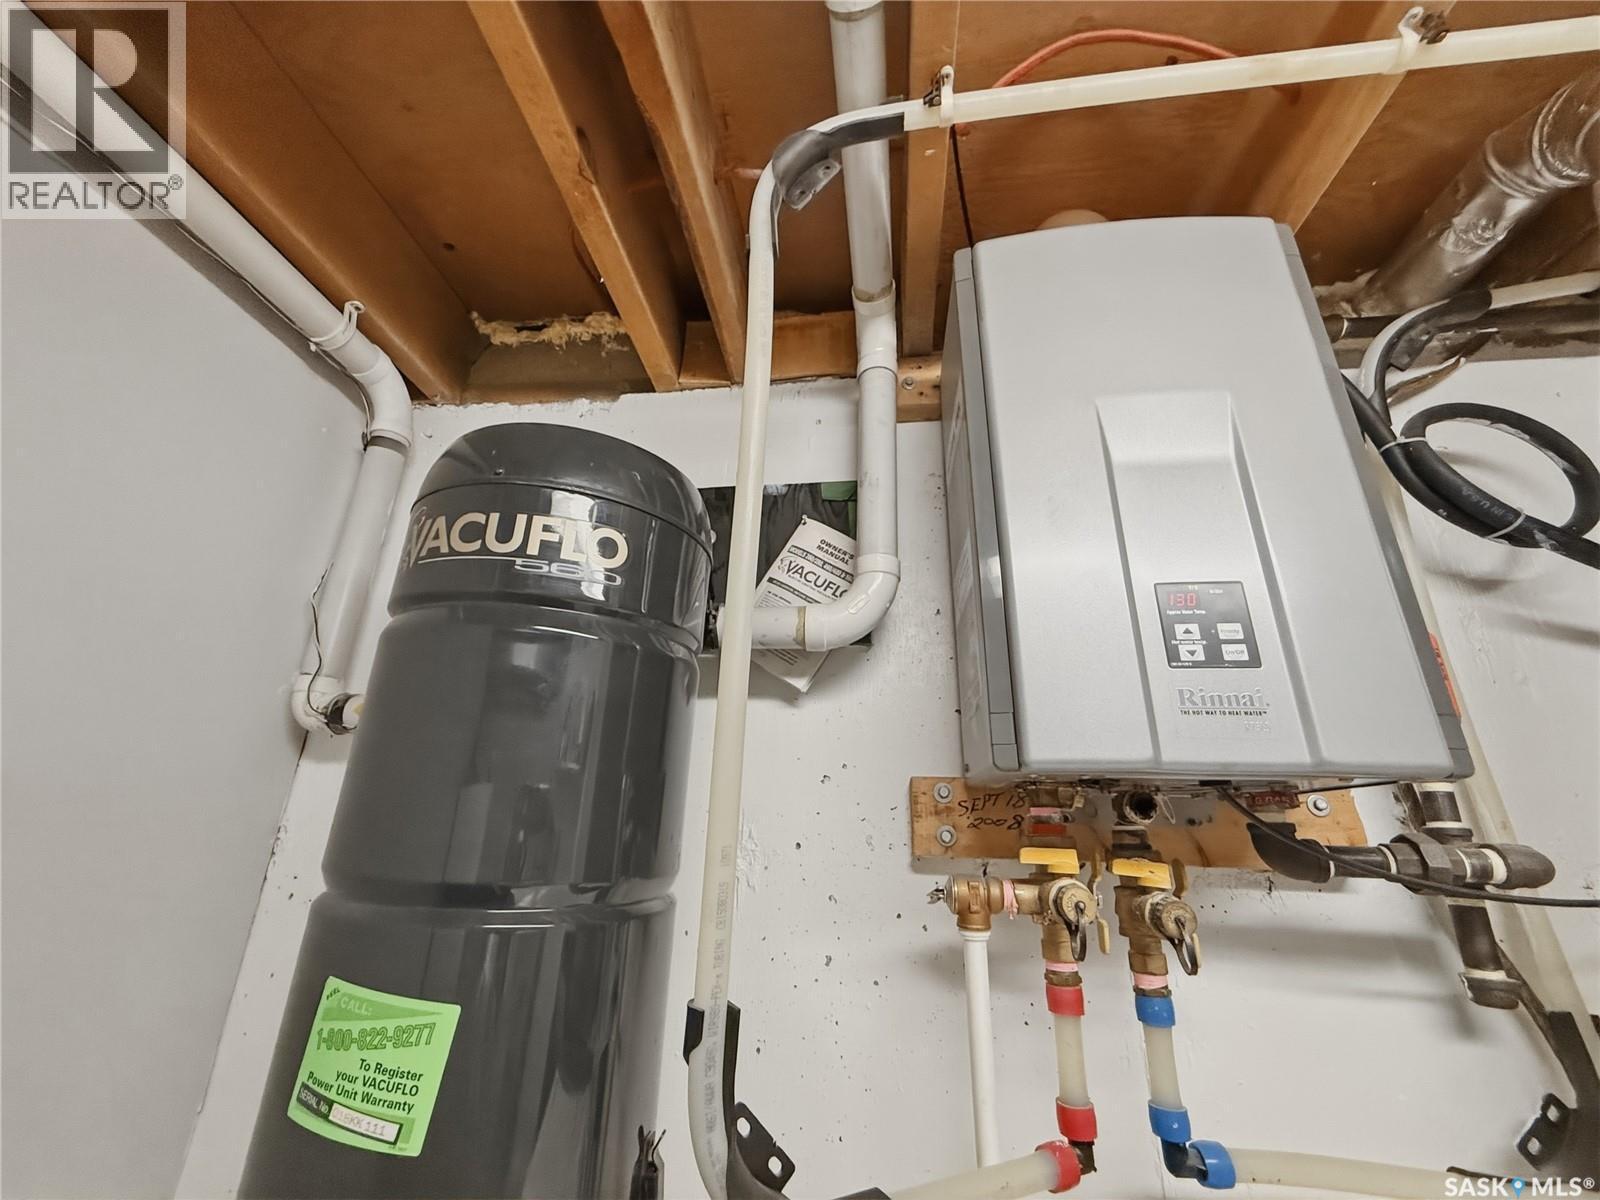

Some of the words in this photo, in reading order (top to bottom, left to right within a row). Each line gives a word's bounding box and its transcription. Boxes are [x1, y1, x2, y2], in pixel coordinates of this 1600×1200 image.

[409, 511, 629, 569] VACUFLO
[819, 538, 855, 560] OWNER'S
[816, 544, 849, 565] MANUAL
[1168, 592, 1196, 607] 130
[967, 814, 1024, 830] 2008
[317, 1023, 436, 1051] 1-800-822-9277
[359, 1058, 371, 1072] To
[374, 1062, 424, 1082] Register
[307, 1071, 334, 1093] Power
[336, 1083, 358, 1101] Unit
[361, 1091, 415, 1115] Warranty
[335, 1070, 359, 1084] your
[362, 1075, 419, 1097] VACUFLO
